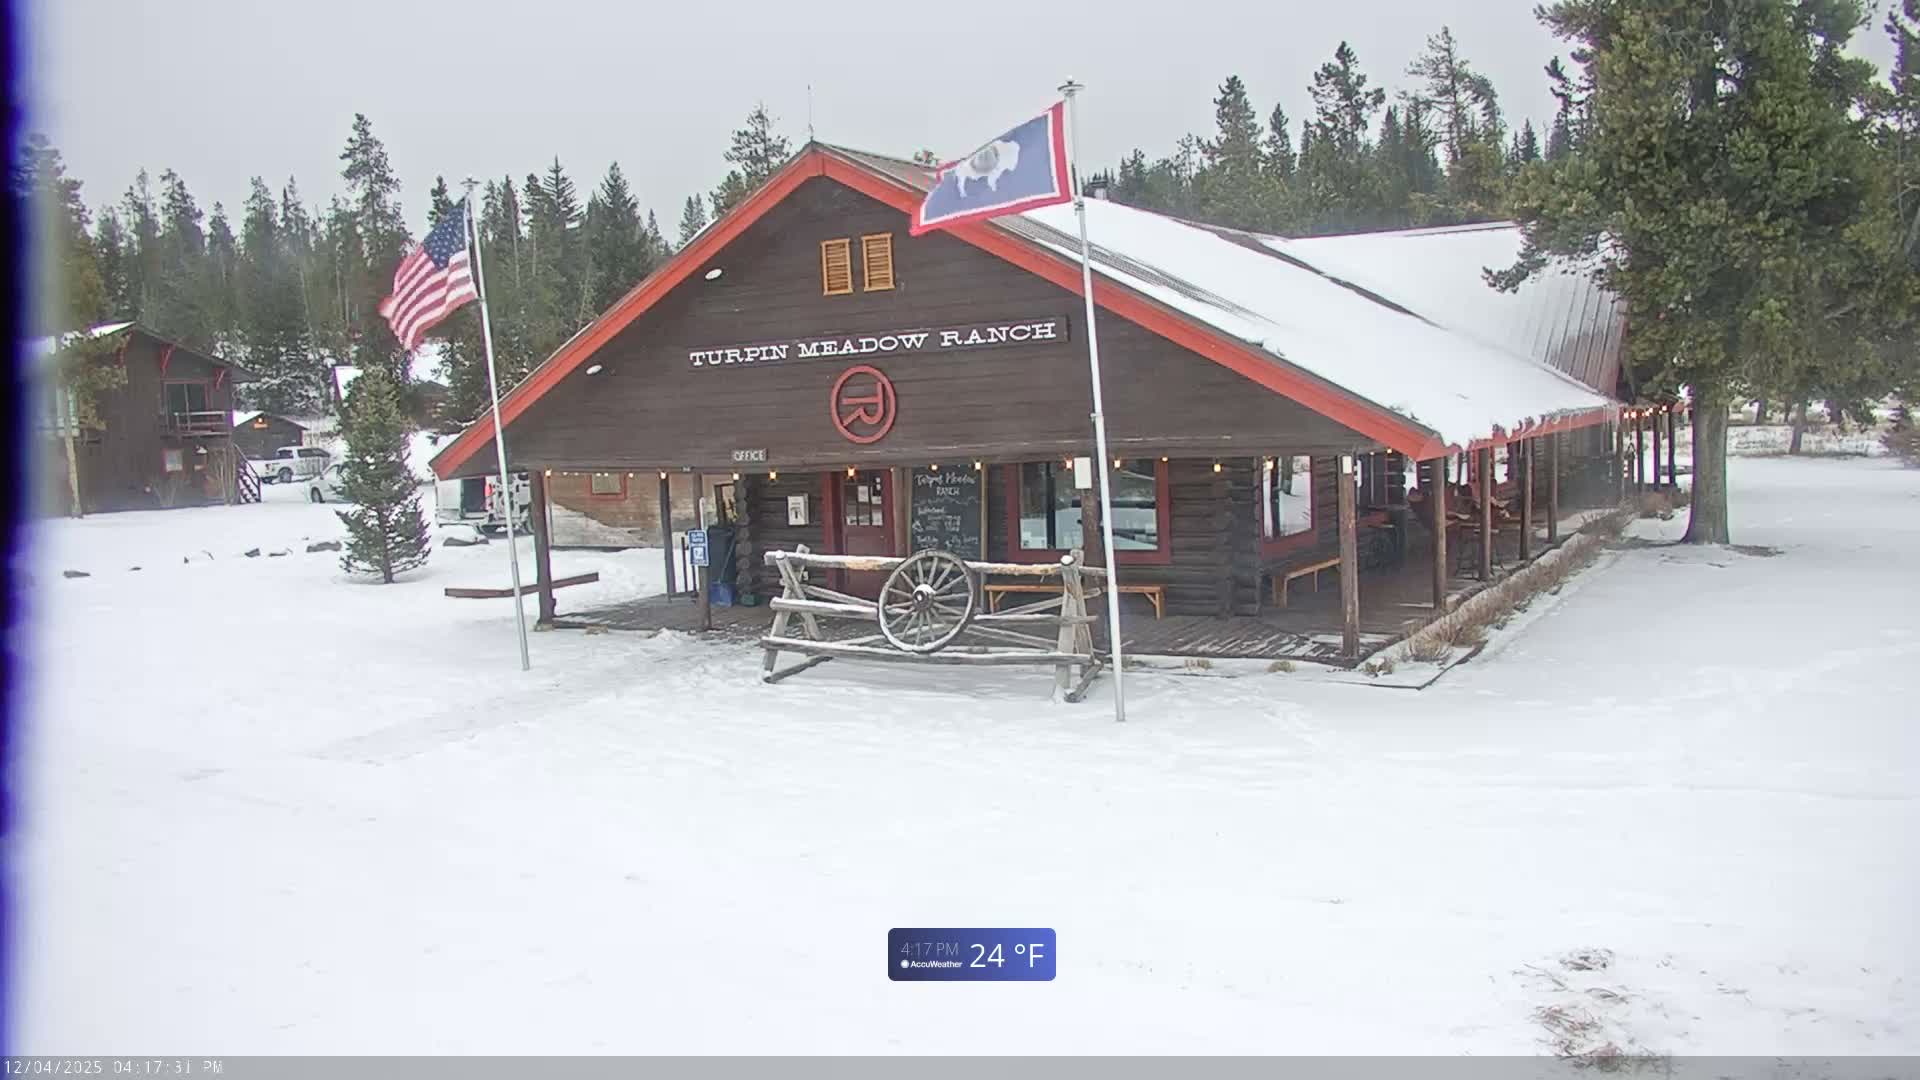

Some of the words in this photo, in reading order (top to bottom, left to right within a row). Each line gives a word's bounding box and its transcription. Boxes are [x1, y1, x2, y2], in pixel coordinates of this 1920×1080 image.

[690, 344, 789, 366] TURPIN
[798, 333, 929, 358] MEADOW
[940, 322, 1056, 347] RANCH
[733, 450, 765, 462] OFFICE
